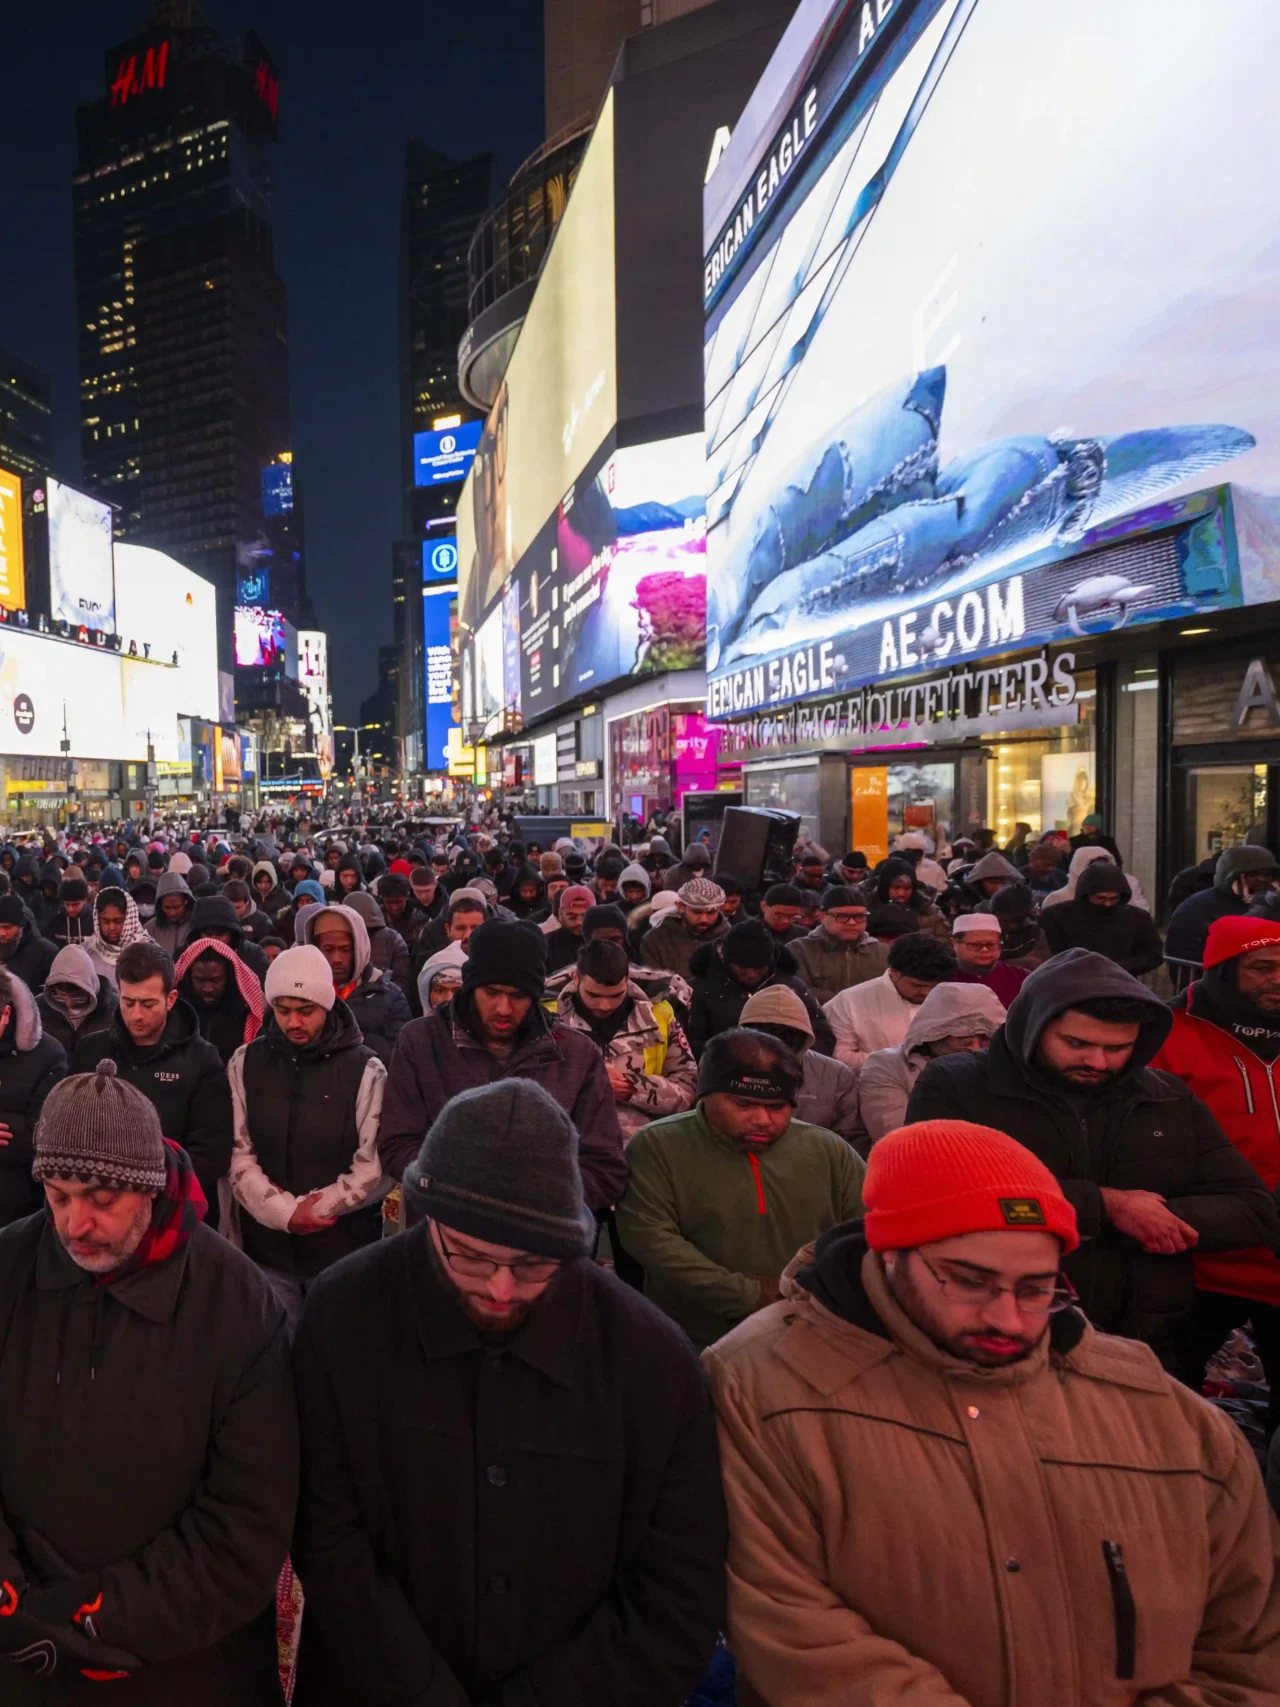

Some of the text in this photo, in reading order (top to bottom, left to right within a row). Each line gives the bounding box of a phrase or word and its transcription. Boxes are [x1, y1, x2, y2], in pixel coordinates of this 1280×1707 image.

[111, 40, 169, 108] H&M
[757, 87, 818, 213] EAGLE
[879, 575, 1025, 674] AE.COM
[768, 642, 835, 698] EAGLE
[797, 694, 864, 741] EAGLE
[865, 651, 1078, 733] OUTFITTERS
[154, 1072, 180, 1080] GUESS
